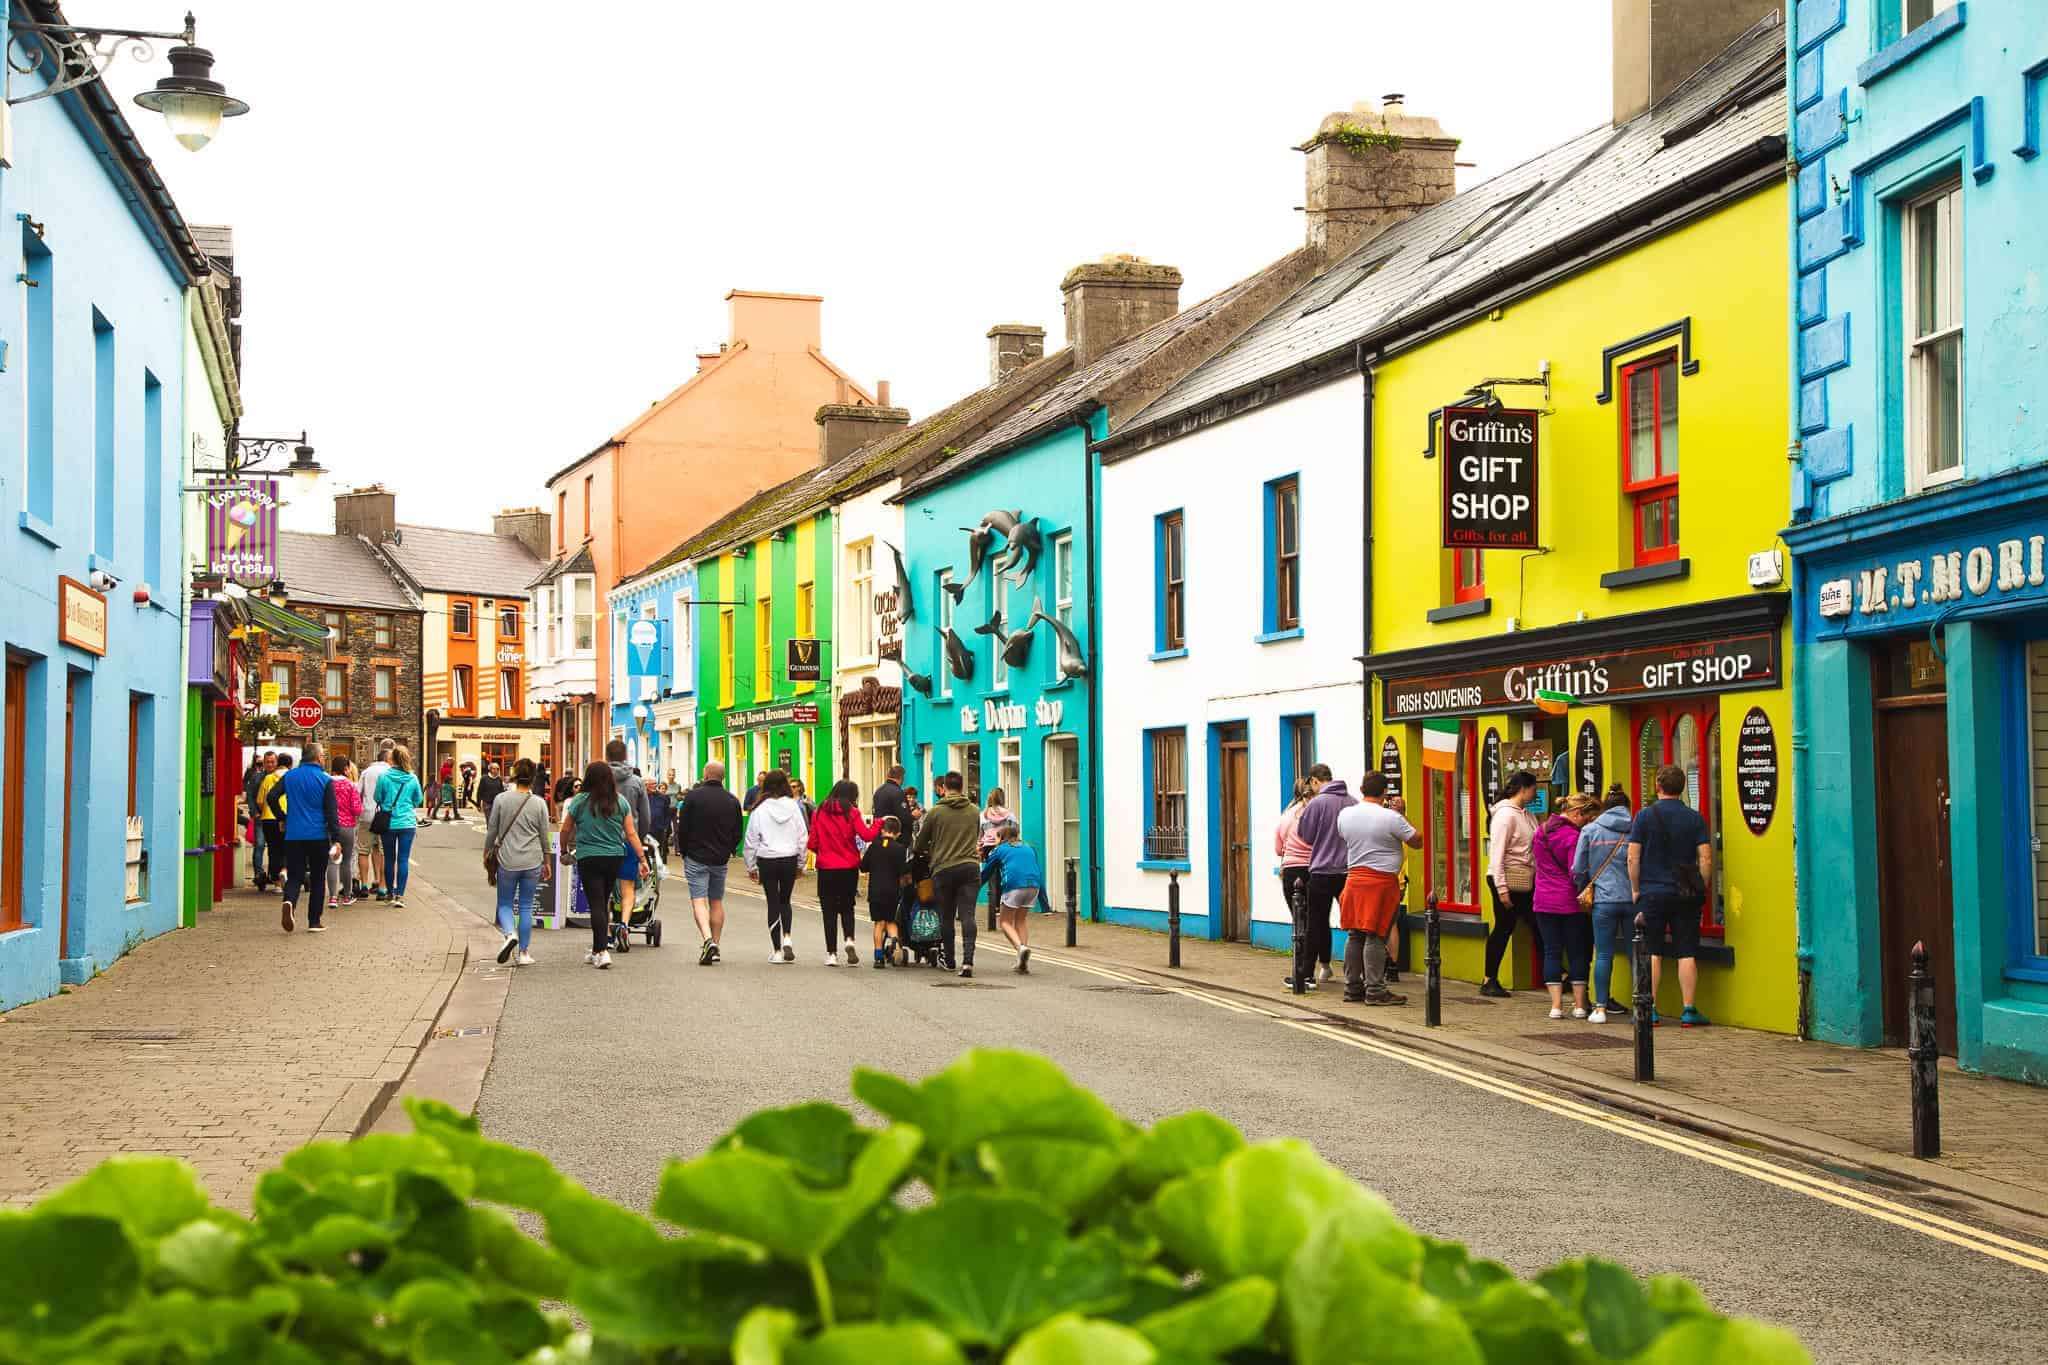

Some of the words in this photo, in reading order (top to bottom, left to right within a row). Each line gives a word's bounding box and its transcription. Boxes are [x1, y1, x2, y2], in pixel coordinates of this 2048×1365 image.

[1449, 418, 1533, 444] Griffin's
[1459, 456, 1523, 483] GIFT
[1451, 492, 1530, 520] SHOP
[1488, 530, 1506, 542] for
[1511, 530, 1528, 542] all
[212, 562, 228, 574] Ice
[232, 561, 274, 574] Cream
[1821, 588, 1841, 602] SURE
[1396, 692, 1422, 713] IRISH
[1423, 686, 1482, 711] SOUVENIRS
[1503, 659, 1609, 702] Griffin's
[1642, 661, 1687, 688] GIFT
[1691, 654, 1752, 684] SHOP
[291, 707, 321, 718] STOP
[984, 699, 1027, 736] Dolphin
[1755, 726, 1771, 735] SHOP
